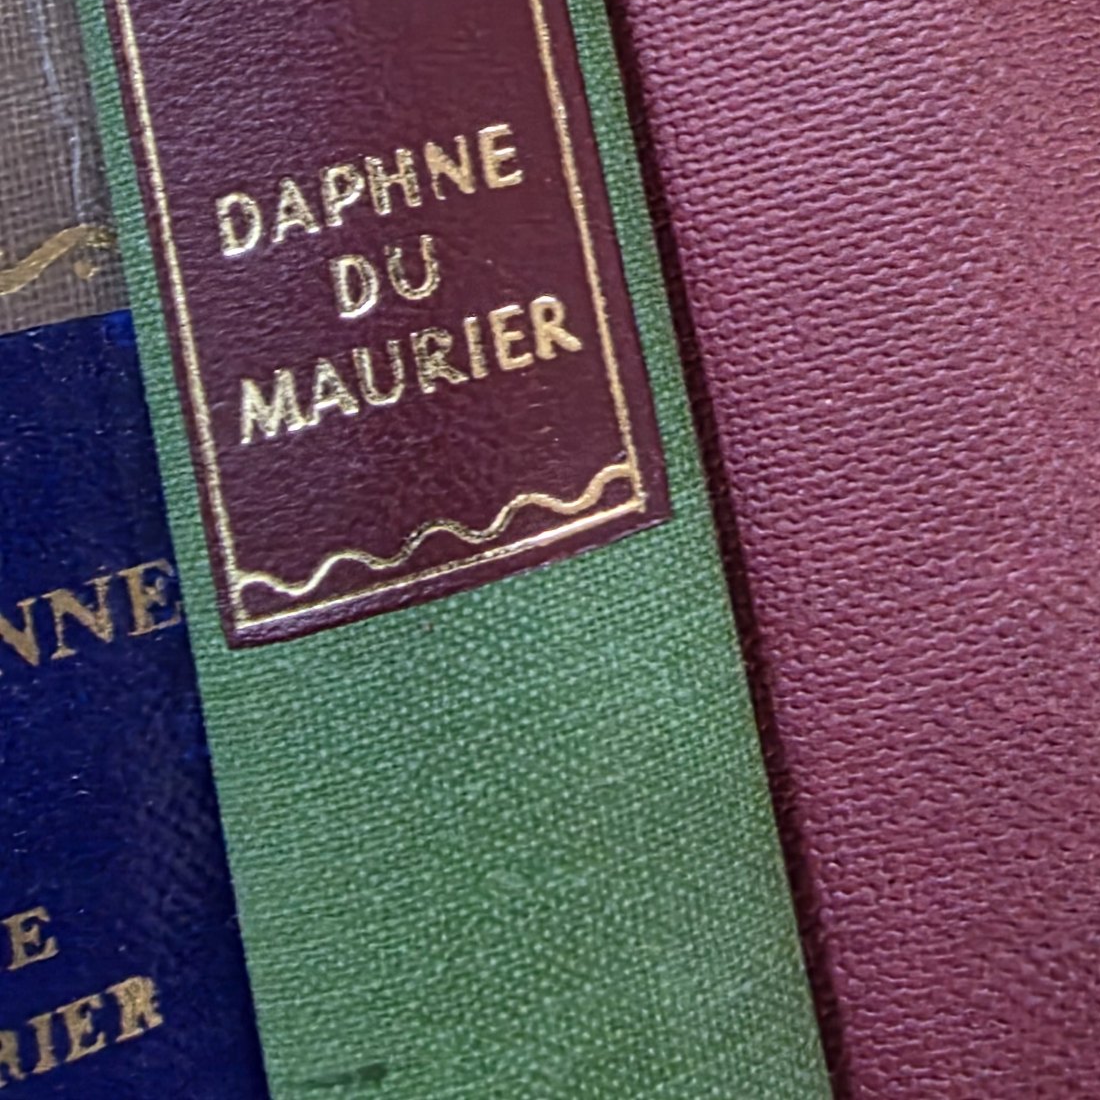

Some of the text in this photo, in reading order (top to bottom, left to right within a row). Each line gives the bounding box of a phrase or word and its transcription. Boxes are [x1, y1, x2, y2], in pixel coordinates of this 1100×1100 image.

[215, 124, 525, 257] DAPHNE
[330, 235, 441, 319] DU
[240, 296, 583, 444] MAURIER
